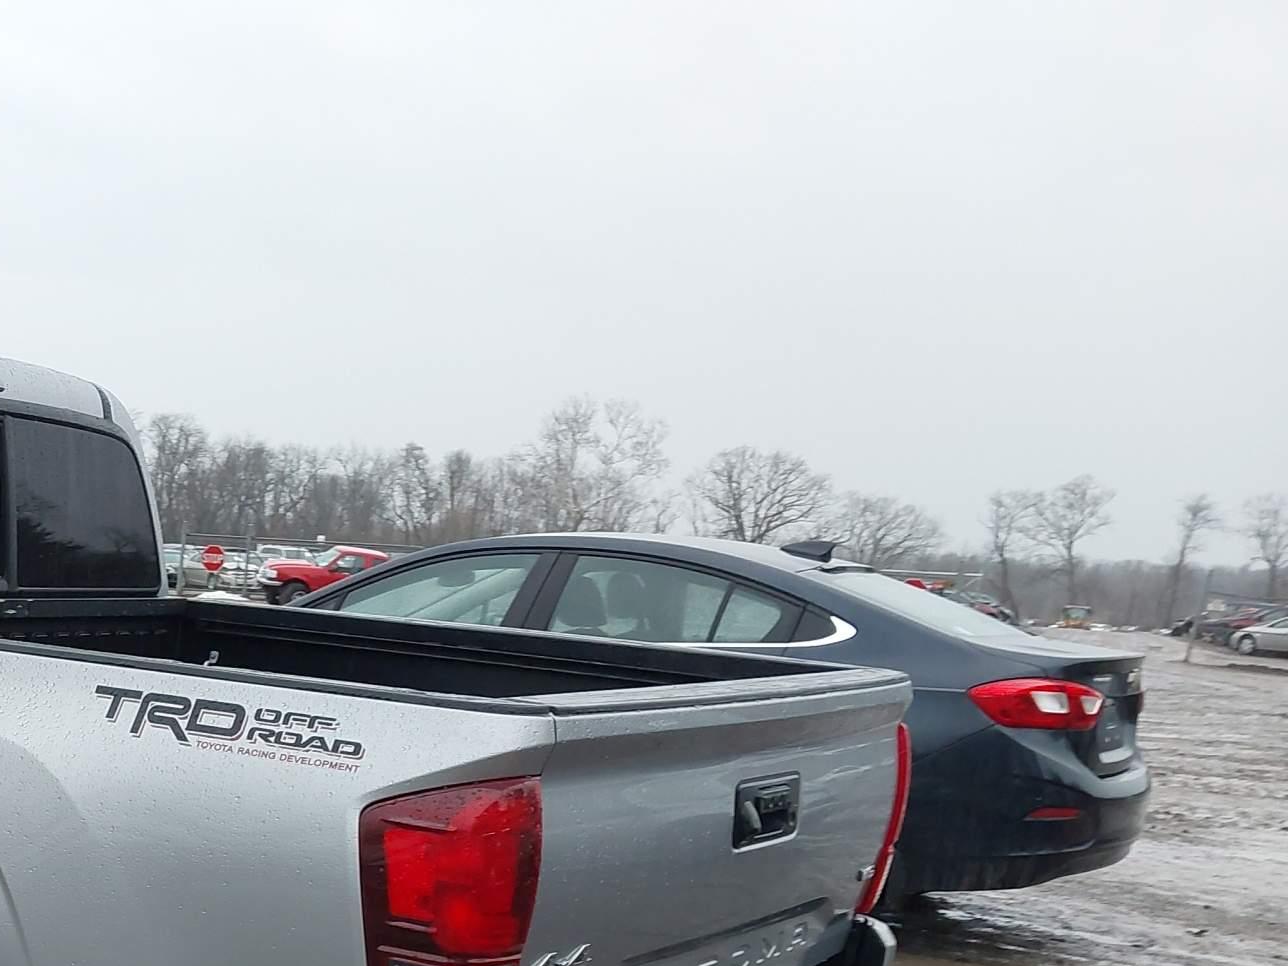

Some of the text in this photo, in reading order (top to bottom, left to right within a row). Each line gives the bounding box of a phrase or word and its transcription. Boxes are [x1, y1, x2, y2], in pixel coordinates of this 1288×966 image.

[95, 684, 248, 746] TRD
[254, 707, 340, 732] OFF
[195, 740, 361, 774] TOYOTA RACING DEVELOPMENT
[247, 726, 364, 760] ROAD
